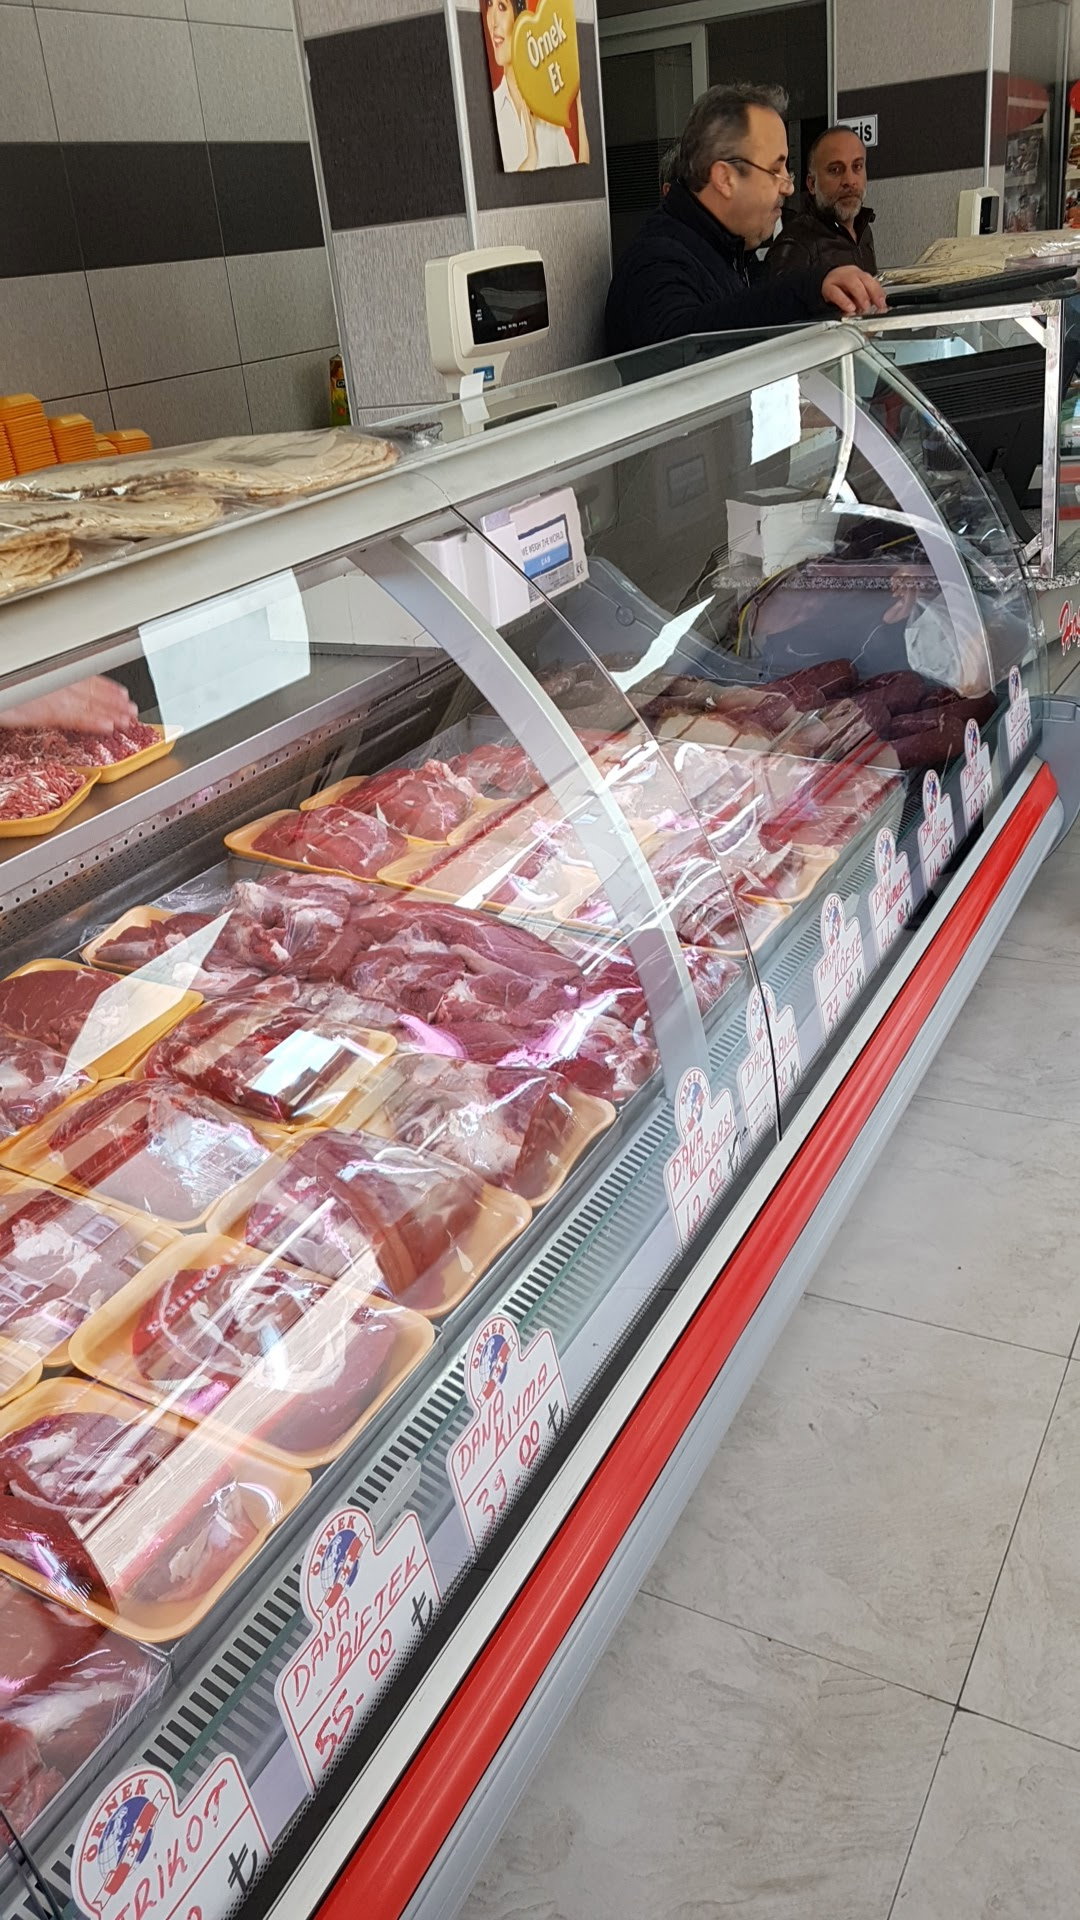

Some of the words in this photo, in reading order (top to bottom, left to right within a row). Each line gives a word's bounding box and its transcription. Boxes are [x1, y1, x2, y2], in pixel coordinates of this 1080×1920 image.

[526, 12, 567, 68] Örnek
[548, 61, 565, 94] Et
[852, 121, 872, 142] İS
[673, 1126, 703, 1192] DANA
[472, 1322, 505, 1369] ÖRNEK
[458, 1389, 504, 1480] DANA
[494, 1363, 548, 1457] KIYMA
[310, 1514, 357, 1576] ÖRNEK
[293, 1596, 350, 1707] DANA
[83, 1779, 149, 1863] ÖRNEK
